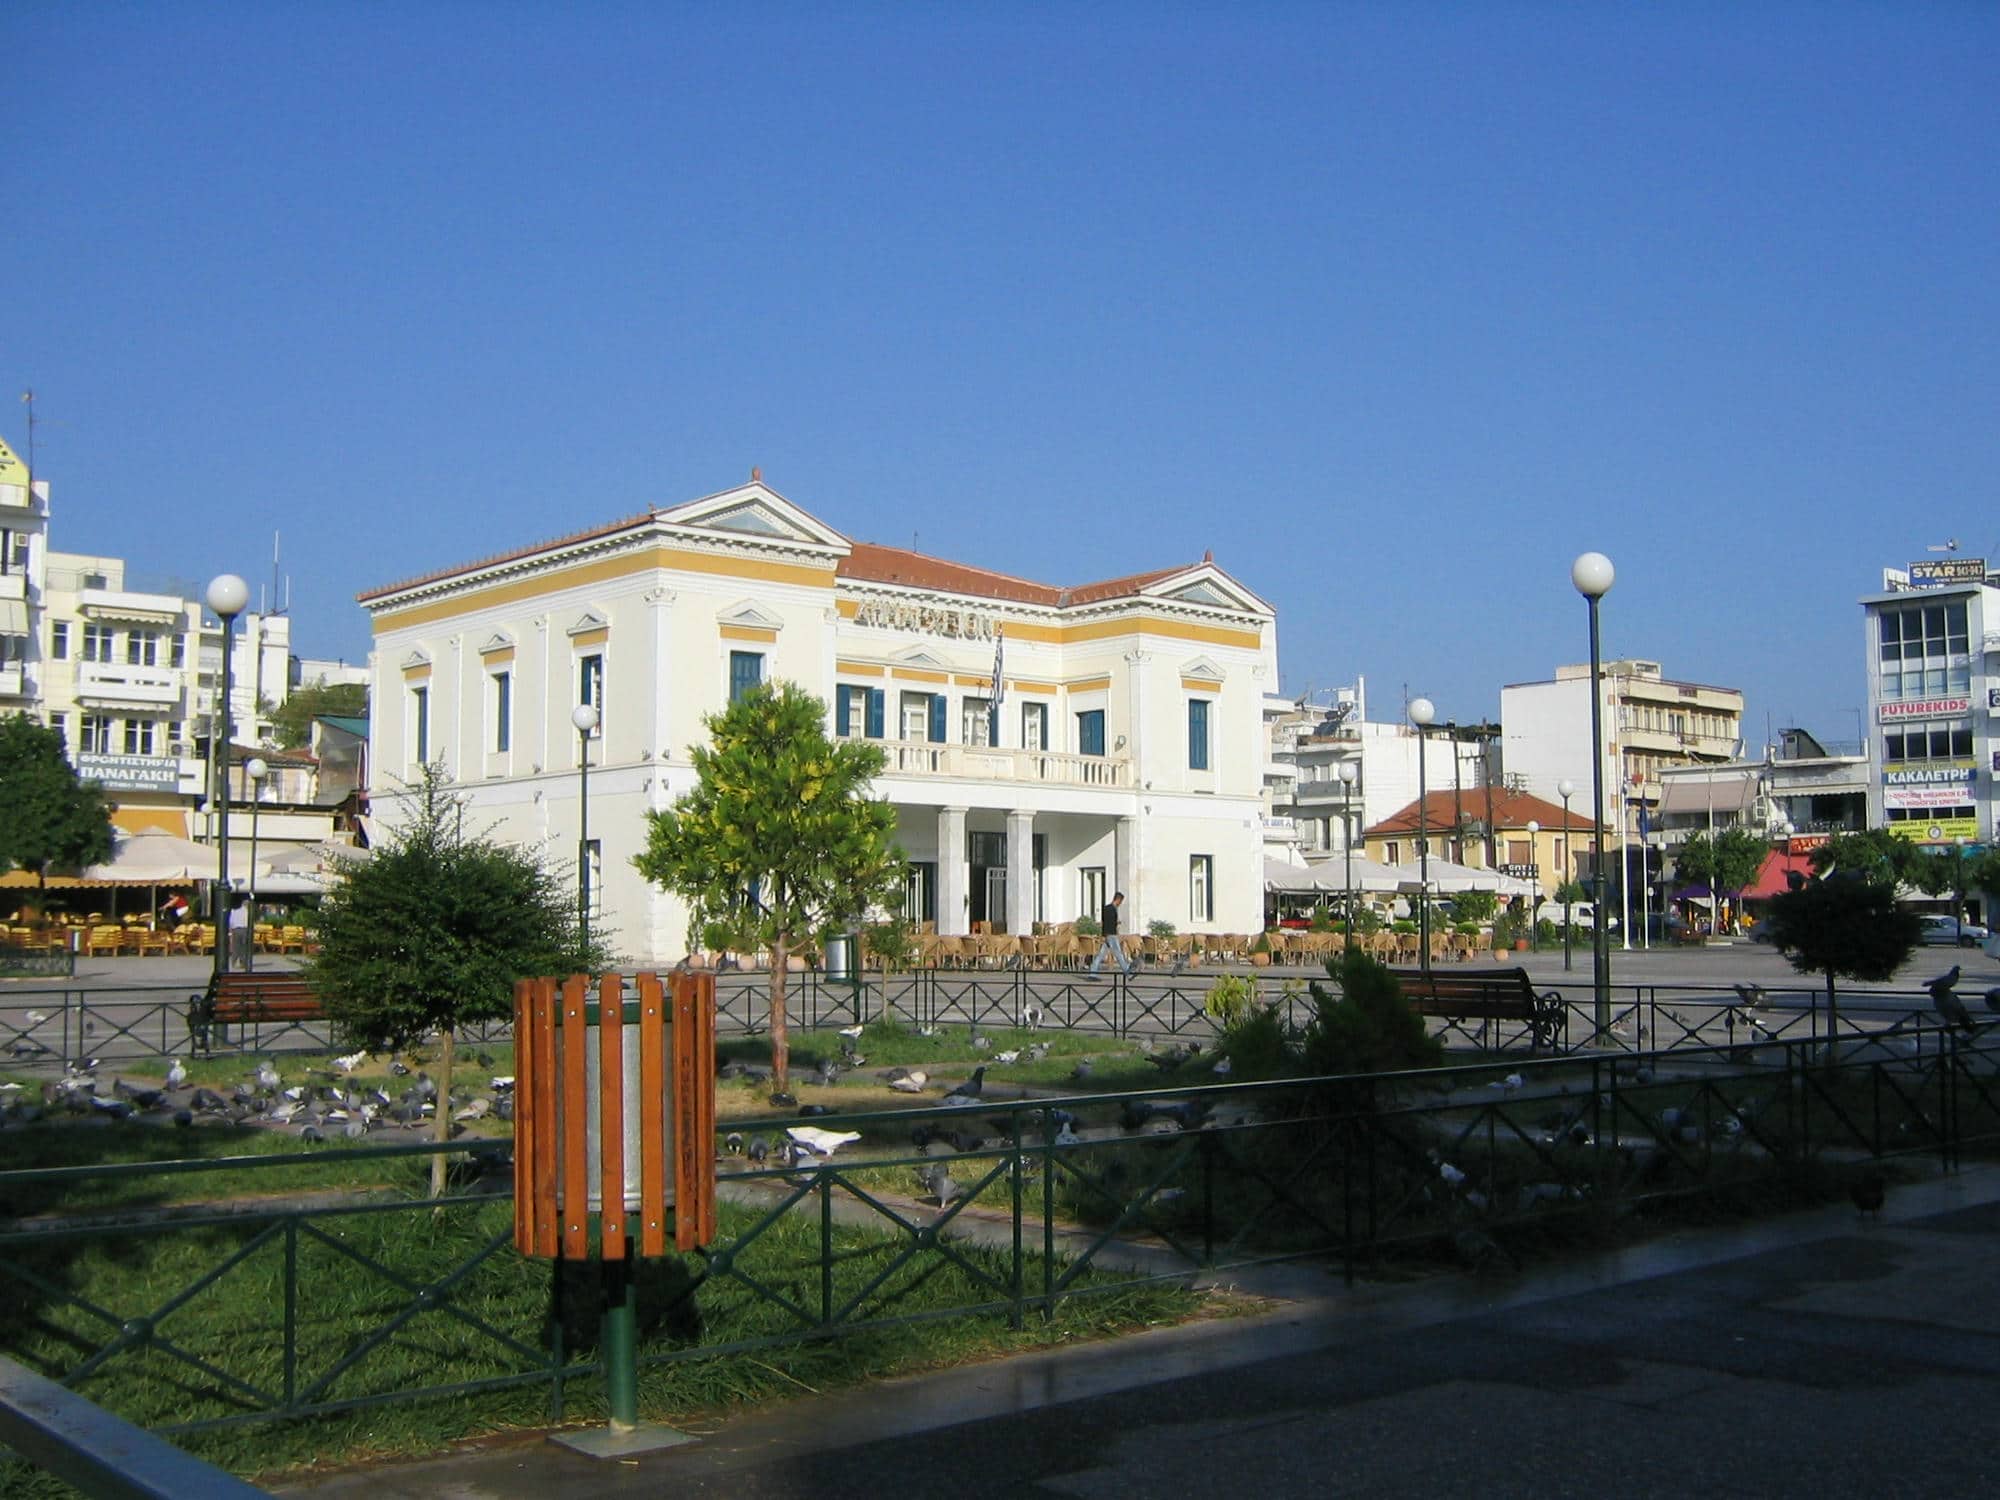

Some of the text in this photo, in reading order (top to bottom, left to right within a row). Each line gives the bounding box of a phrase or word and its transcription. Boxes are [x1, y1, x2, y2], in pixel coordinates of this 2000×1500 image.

[1913, 566, 1955, 578] STAR
[1881, 699, 1968, 715] FUTUREKIDS
[80, 767, 176, 782] ΠΑΝΑΓΑΚΗ
[1888, 769, 1970, 783] ΚΑΚΑΛΕΤΡΗ
